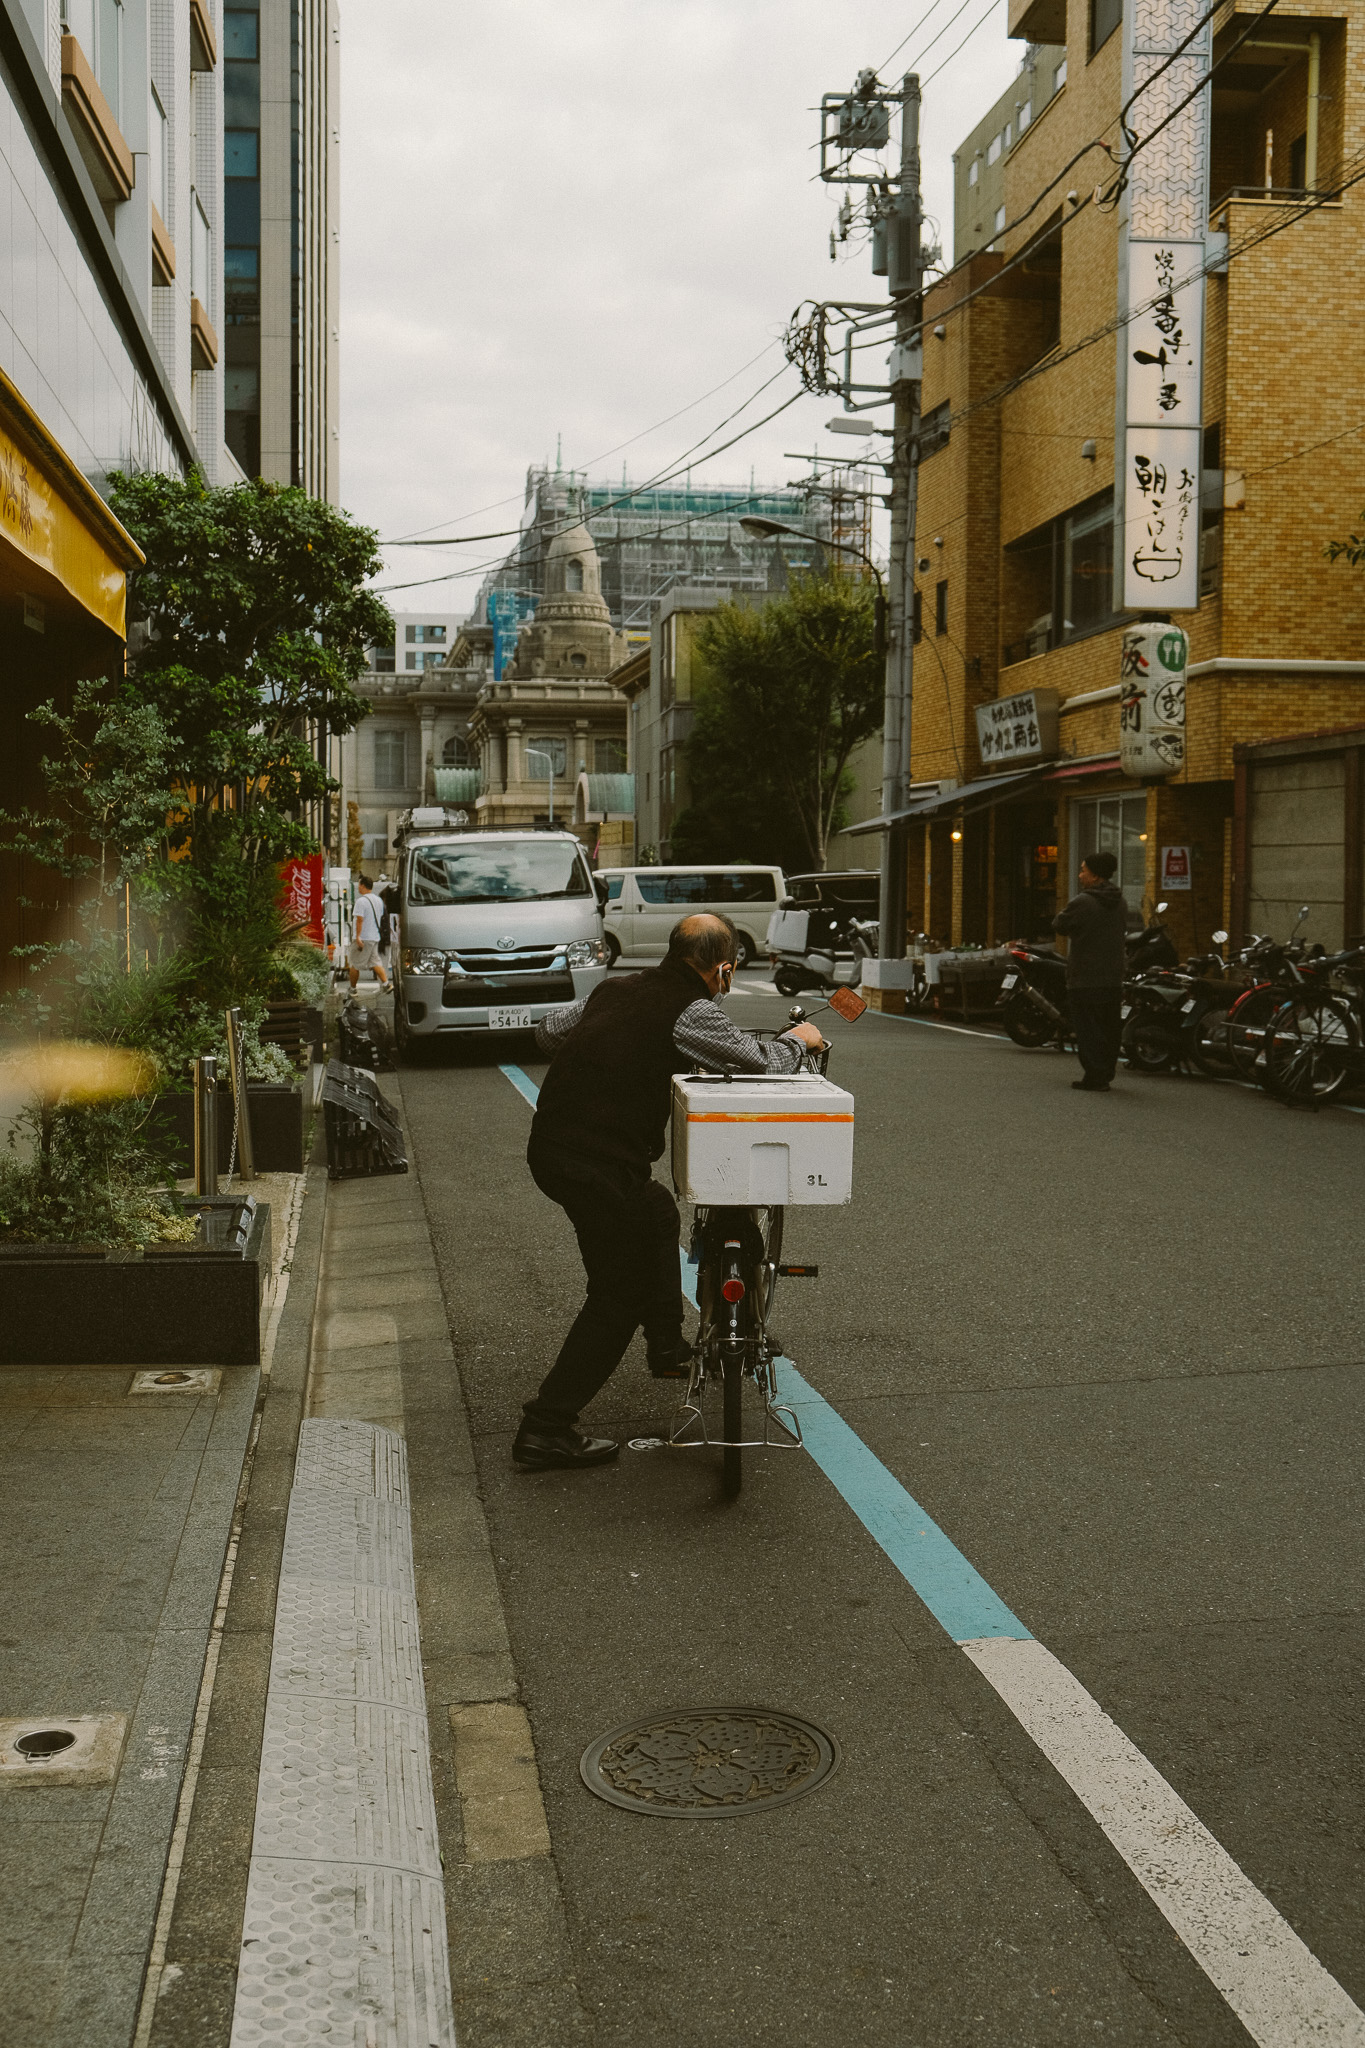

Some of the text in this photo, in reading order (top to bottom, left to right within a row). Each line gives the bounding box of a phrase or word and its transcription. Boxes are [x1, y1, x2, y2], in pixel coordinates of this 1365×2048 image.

[1134, 454, 1167, 553] 朝ごはん
[498, 1015, 529, 1028] 54-16
[806, 1174, 828, 1187] 3L
